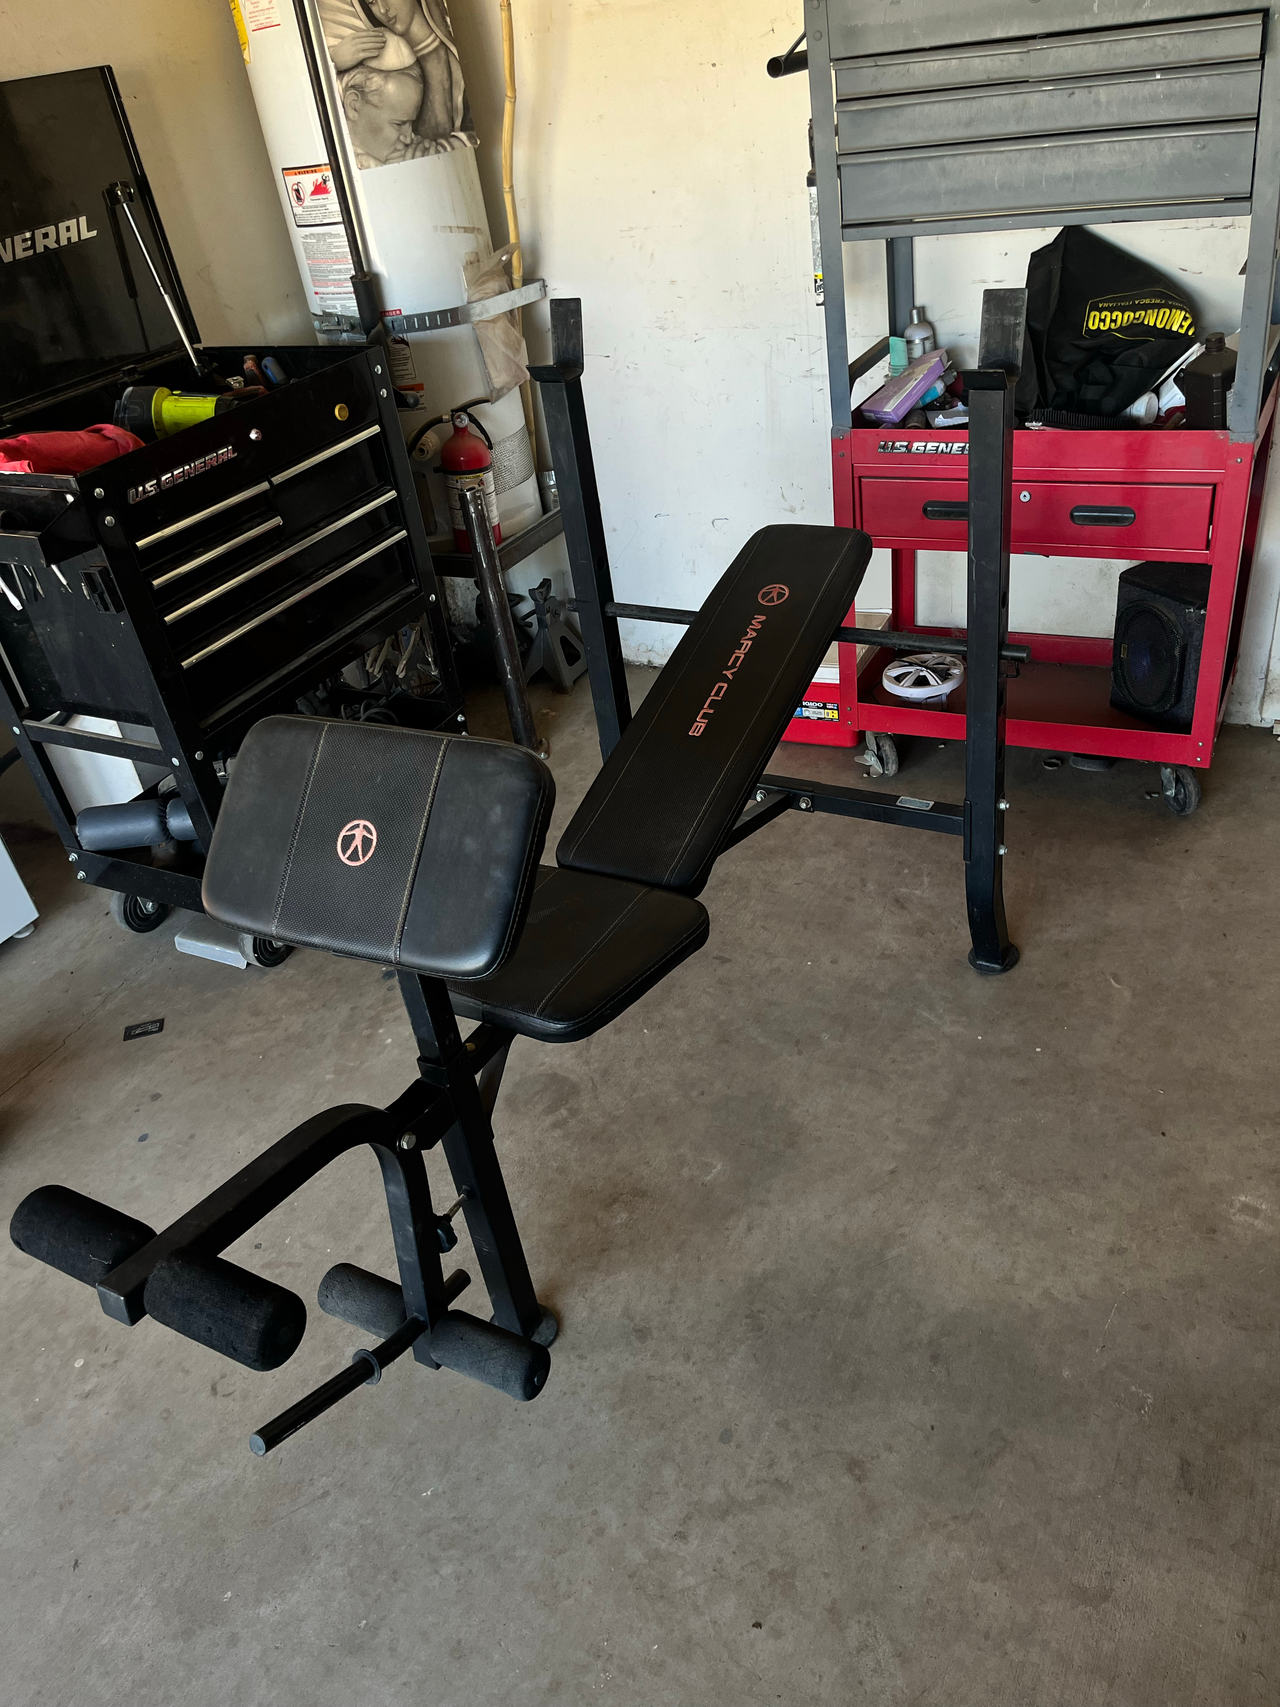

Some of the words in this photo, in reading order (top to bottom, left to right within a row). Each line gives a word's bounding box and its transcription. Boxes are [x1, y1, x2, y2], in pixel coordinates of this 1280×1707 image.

[161, 445, 238, 490] GENERAL
[910, 441, 969, 454] GENE
[722, 614, 767, 680] MARCY
[688, 682, 728, 737] CLUB
